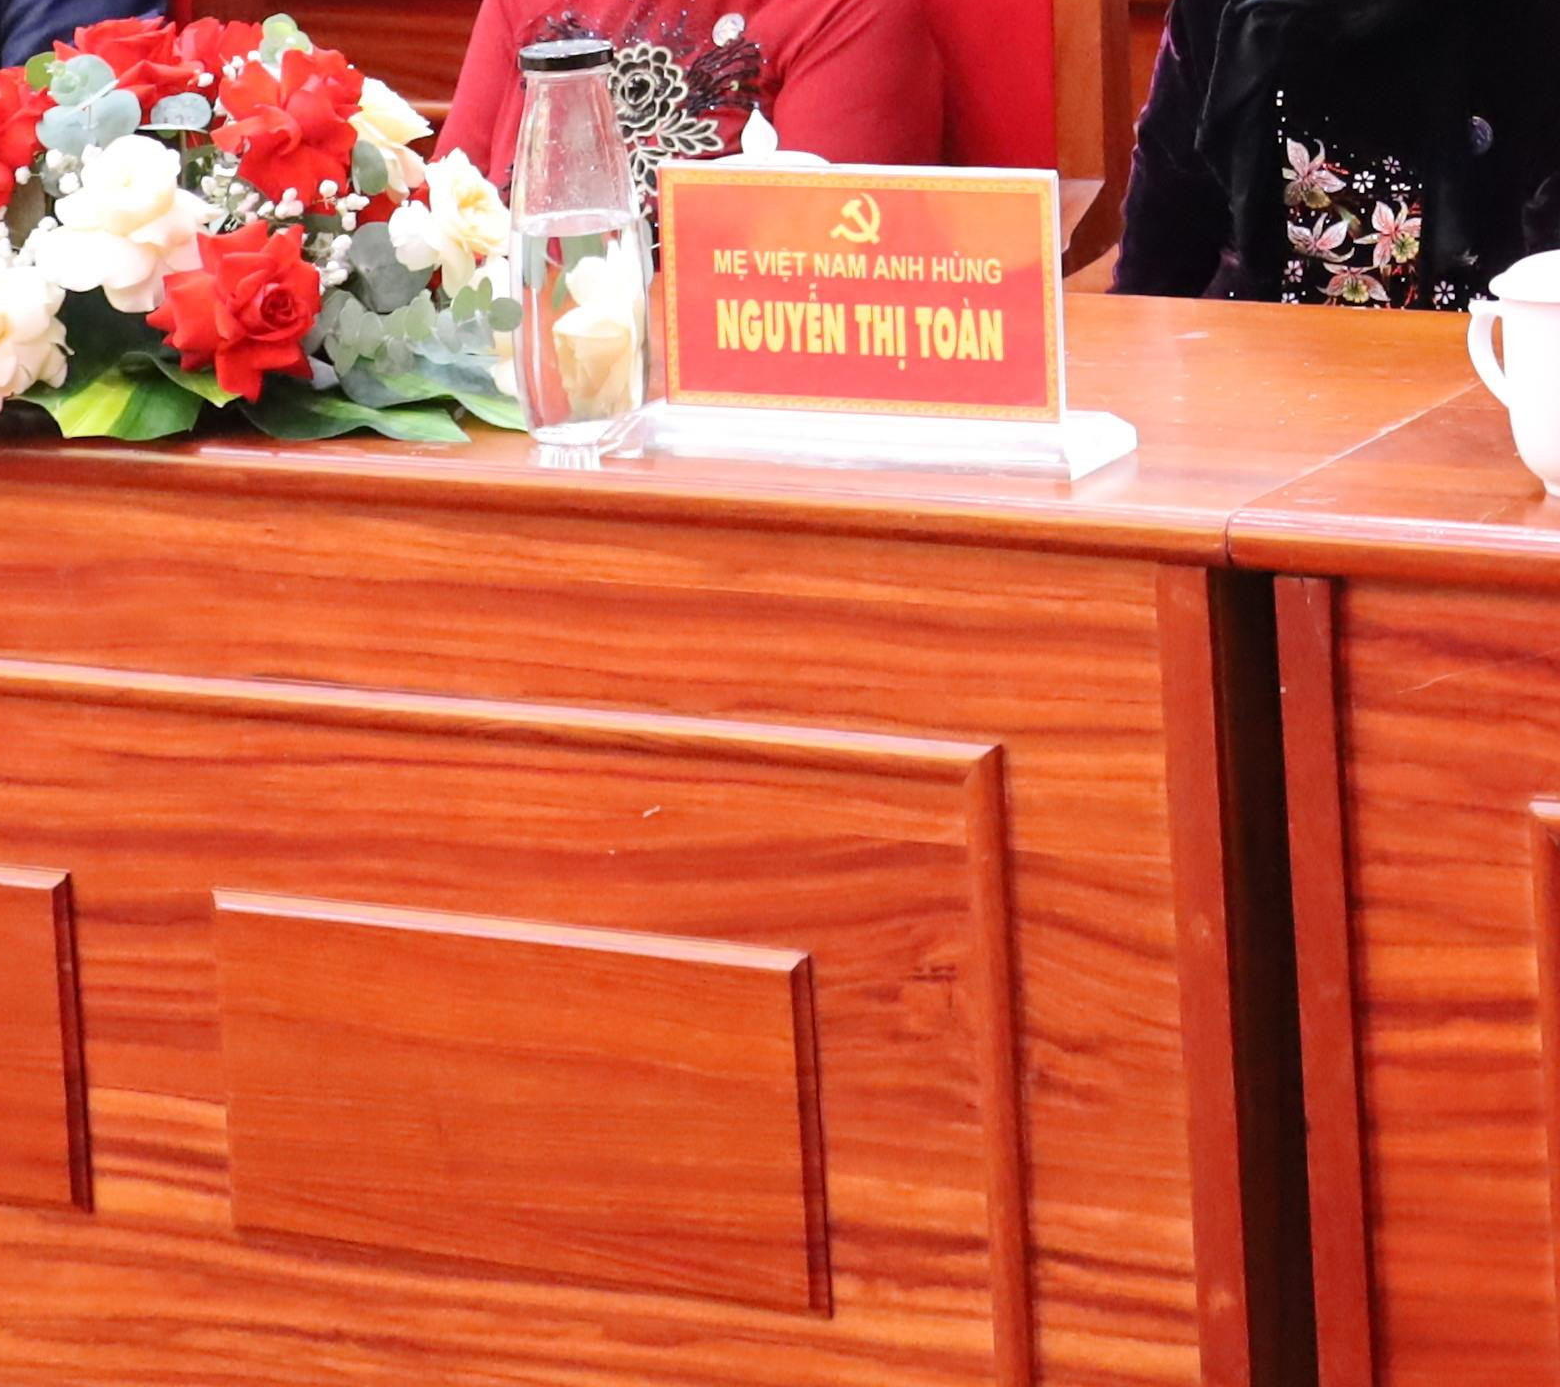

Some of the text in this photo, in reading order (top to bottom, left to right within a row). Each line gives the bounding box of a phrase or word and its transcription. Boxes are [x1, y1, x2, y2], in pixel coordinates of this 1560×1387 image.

[714, 248, 1002, 284] MẸ VIỆT NAM ANH HÙNG
[716, 283, 1003, 370] NGUYỄN THỊ TOÀN
